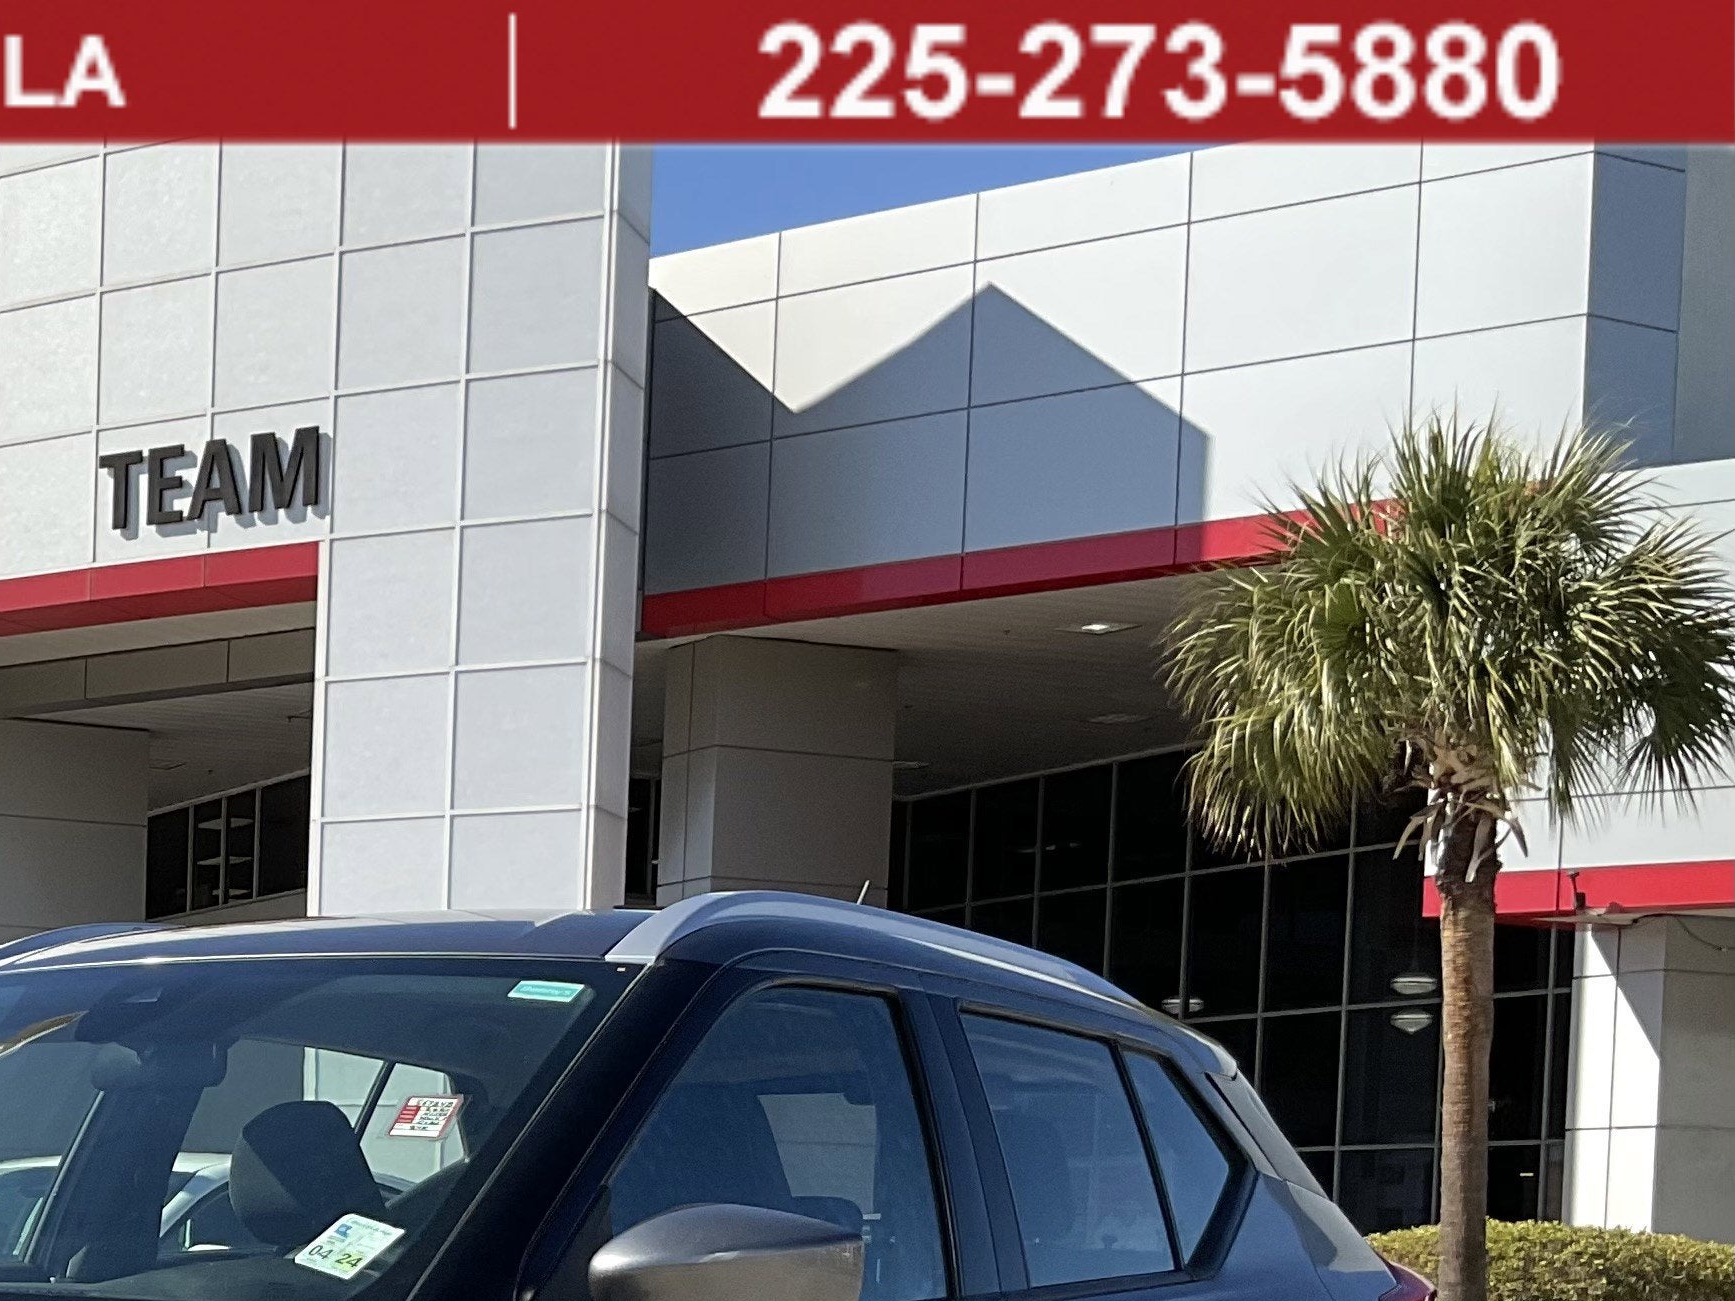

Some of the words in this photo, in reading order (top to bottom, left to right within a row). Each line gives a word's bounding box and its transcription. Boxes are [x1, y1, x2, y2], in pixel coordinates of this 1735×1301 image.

[98, 426, 322, 531] TEAM
[308, 1244, 334, 1260] 04
[334, 1253, 364, 1268] 24
